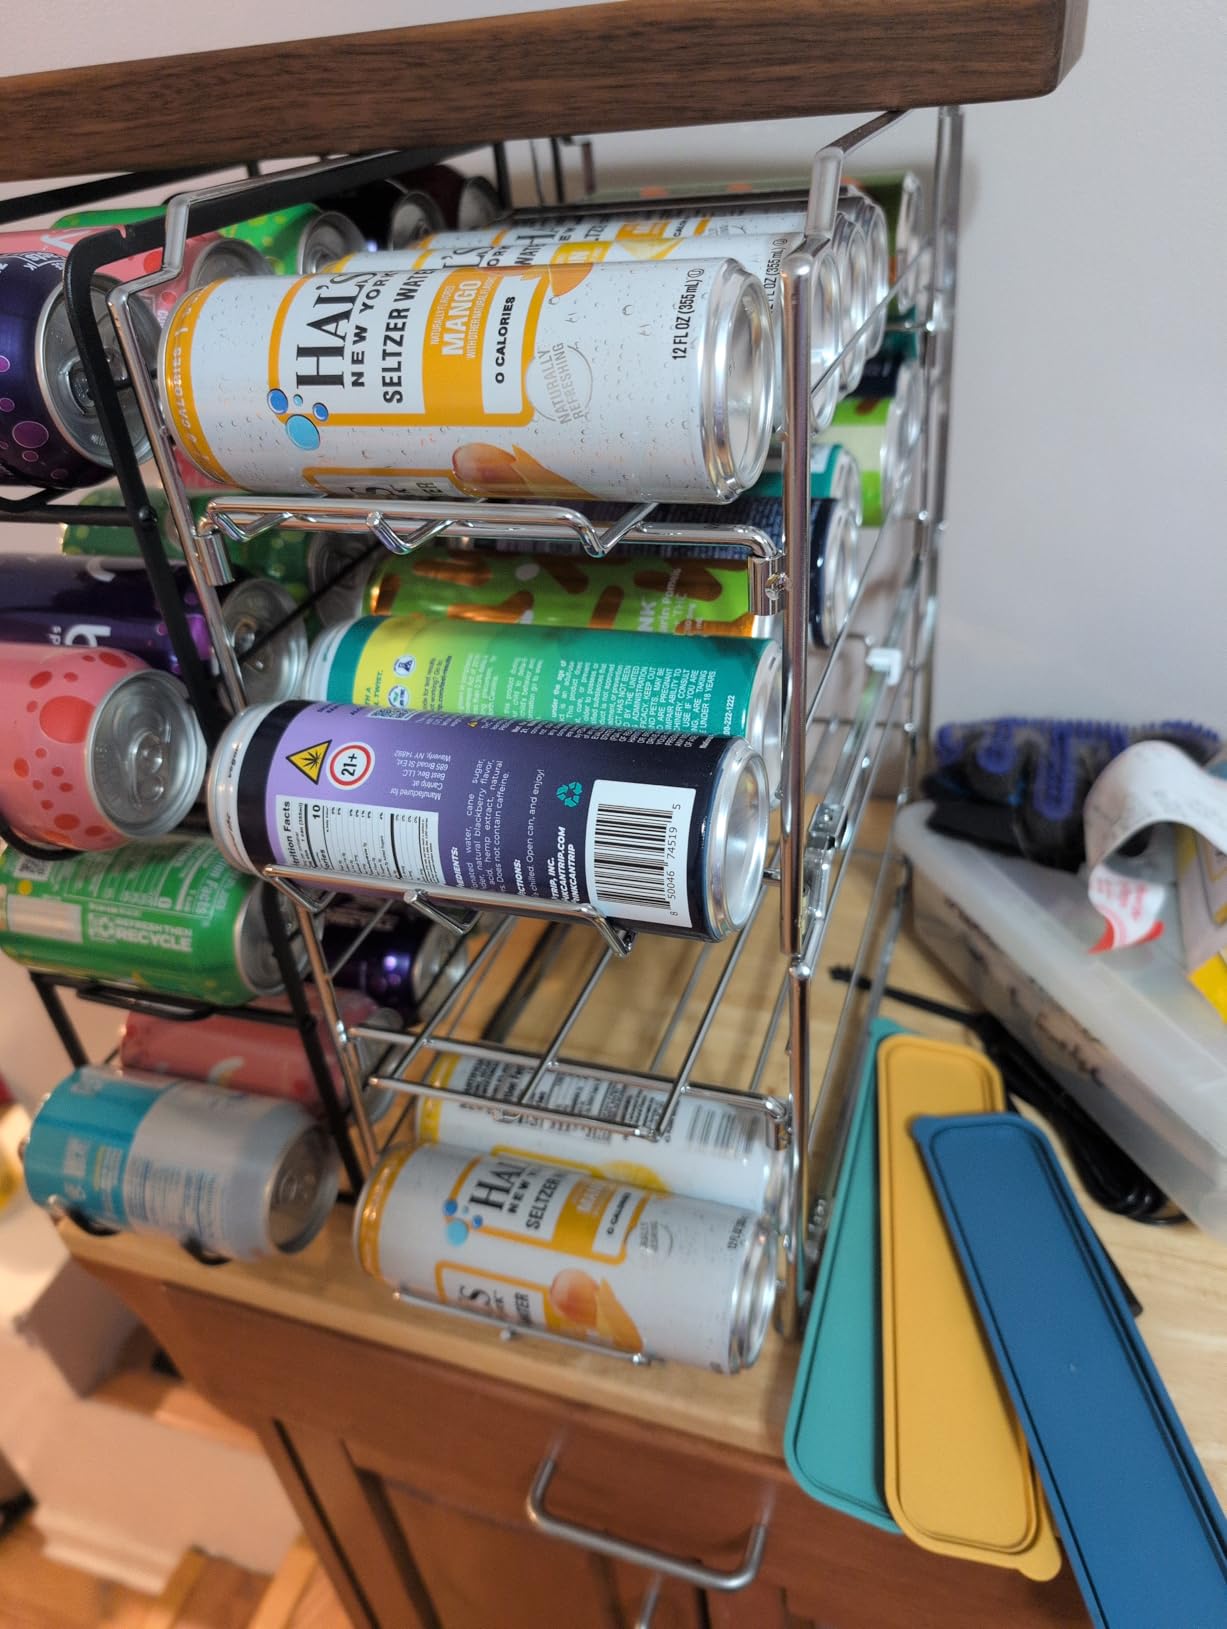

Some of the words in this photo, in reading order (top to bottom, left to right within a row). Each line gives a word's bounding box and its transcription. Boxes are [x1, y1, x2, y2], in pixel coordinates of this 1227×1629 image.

[393, 269, 436, 302] WATE
[295, 272, 377, 389] HAL'S
[441, 280, 481, 356] MANGO
[674, 316, 691, 329] OZ
[495, 296, 515, 366] CALORIES
[673, 331, 689, 344] FL
[351, 325, 368, 387] NEW
[381, 308, 411, 404] SELTZER
[672, 347, 688, 360] 12
[537, 350, 572, 424] NATURALLY
[552, 342, 584, 420] REFRESHING
[629, 665, 639, 688] UNITED
[644, 681, 652, 699] KEEP
[648, 667, 656, 680] OUT
[654, 676, 662, 691] MAY
[657, 668, 665, 676] BE
[673, 668, 681, 677] TO
[678, 669, 690, 698] CONSULT
[689, 670, 699, 682] ARE
[696, 670, 707, 692] TAKING
[569, 678, 578, 701] product
[616, 699, 624, 713] HAS
[622, 665, 631, 681] BEEN
[633, 666, 648, 721] ADMINISTRATION
[660, 668, 673, 702] PREGNANT
[669, 679, 679, 704] ABILITY
[686, 685, 696, 699] YOU
[626, 691, 634, 705] THE
[649, 696, 658, 715] PETS.
[693, 698, 702, 712] ARE
[700, 704, 710, 728] UNDER
[706, 671, 716, 692] YEARS
[566, 705, 574, 718] This
[624, 709, 631, 718] BY
[657, 706, 665, 721] ARE
[683, 712, 691, 727] USE
[340, 753, 358, 777] 21+
[416, 761, 435, 769] Broad
[431, 772, 445, 780] Best
[480, 759, 495, 784] flavor,
[489, 760, 503, 790] natural
[390, 788, 399, 796] for
[400, 789, 441, 800] Manufactured
[421, 780, 443, 790] Cantrip
[466, 794, 475, 816] cane
[472, 759, 485, 784] sugar,
[496, 771, 510, 809] caffeine.
[532, 769, 545, 795] enjoy!
[283, 801, 291, 832] Facts
[312, 805, 321, 819] 10
[474, 788, 487, 836] blackberry
[484, 796, 495, 830] extract,
[528, 797, 538, 815] and
[493, 811, 502, 845] contain
[527, 817, 536, 836] can,
[484, 837, 492, 863] hemp
[526, 838, 534, 863] Open
[667, 826, 678, 859] 74519
[474, 841, 483, 870] natural
[547, 857, 556, 876] INC.
[495, 863, 504, 882] Does
[666, 871, 676, 899] 50046
[525, 1177, 562, 1230] SELTZER
